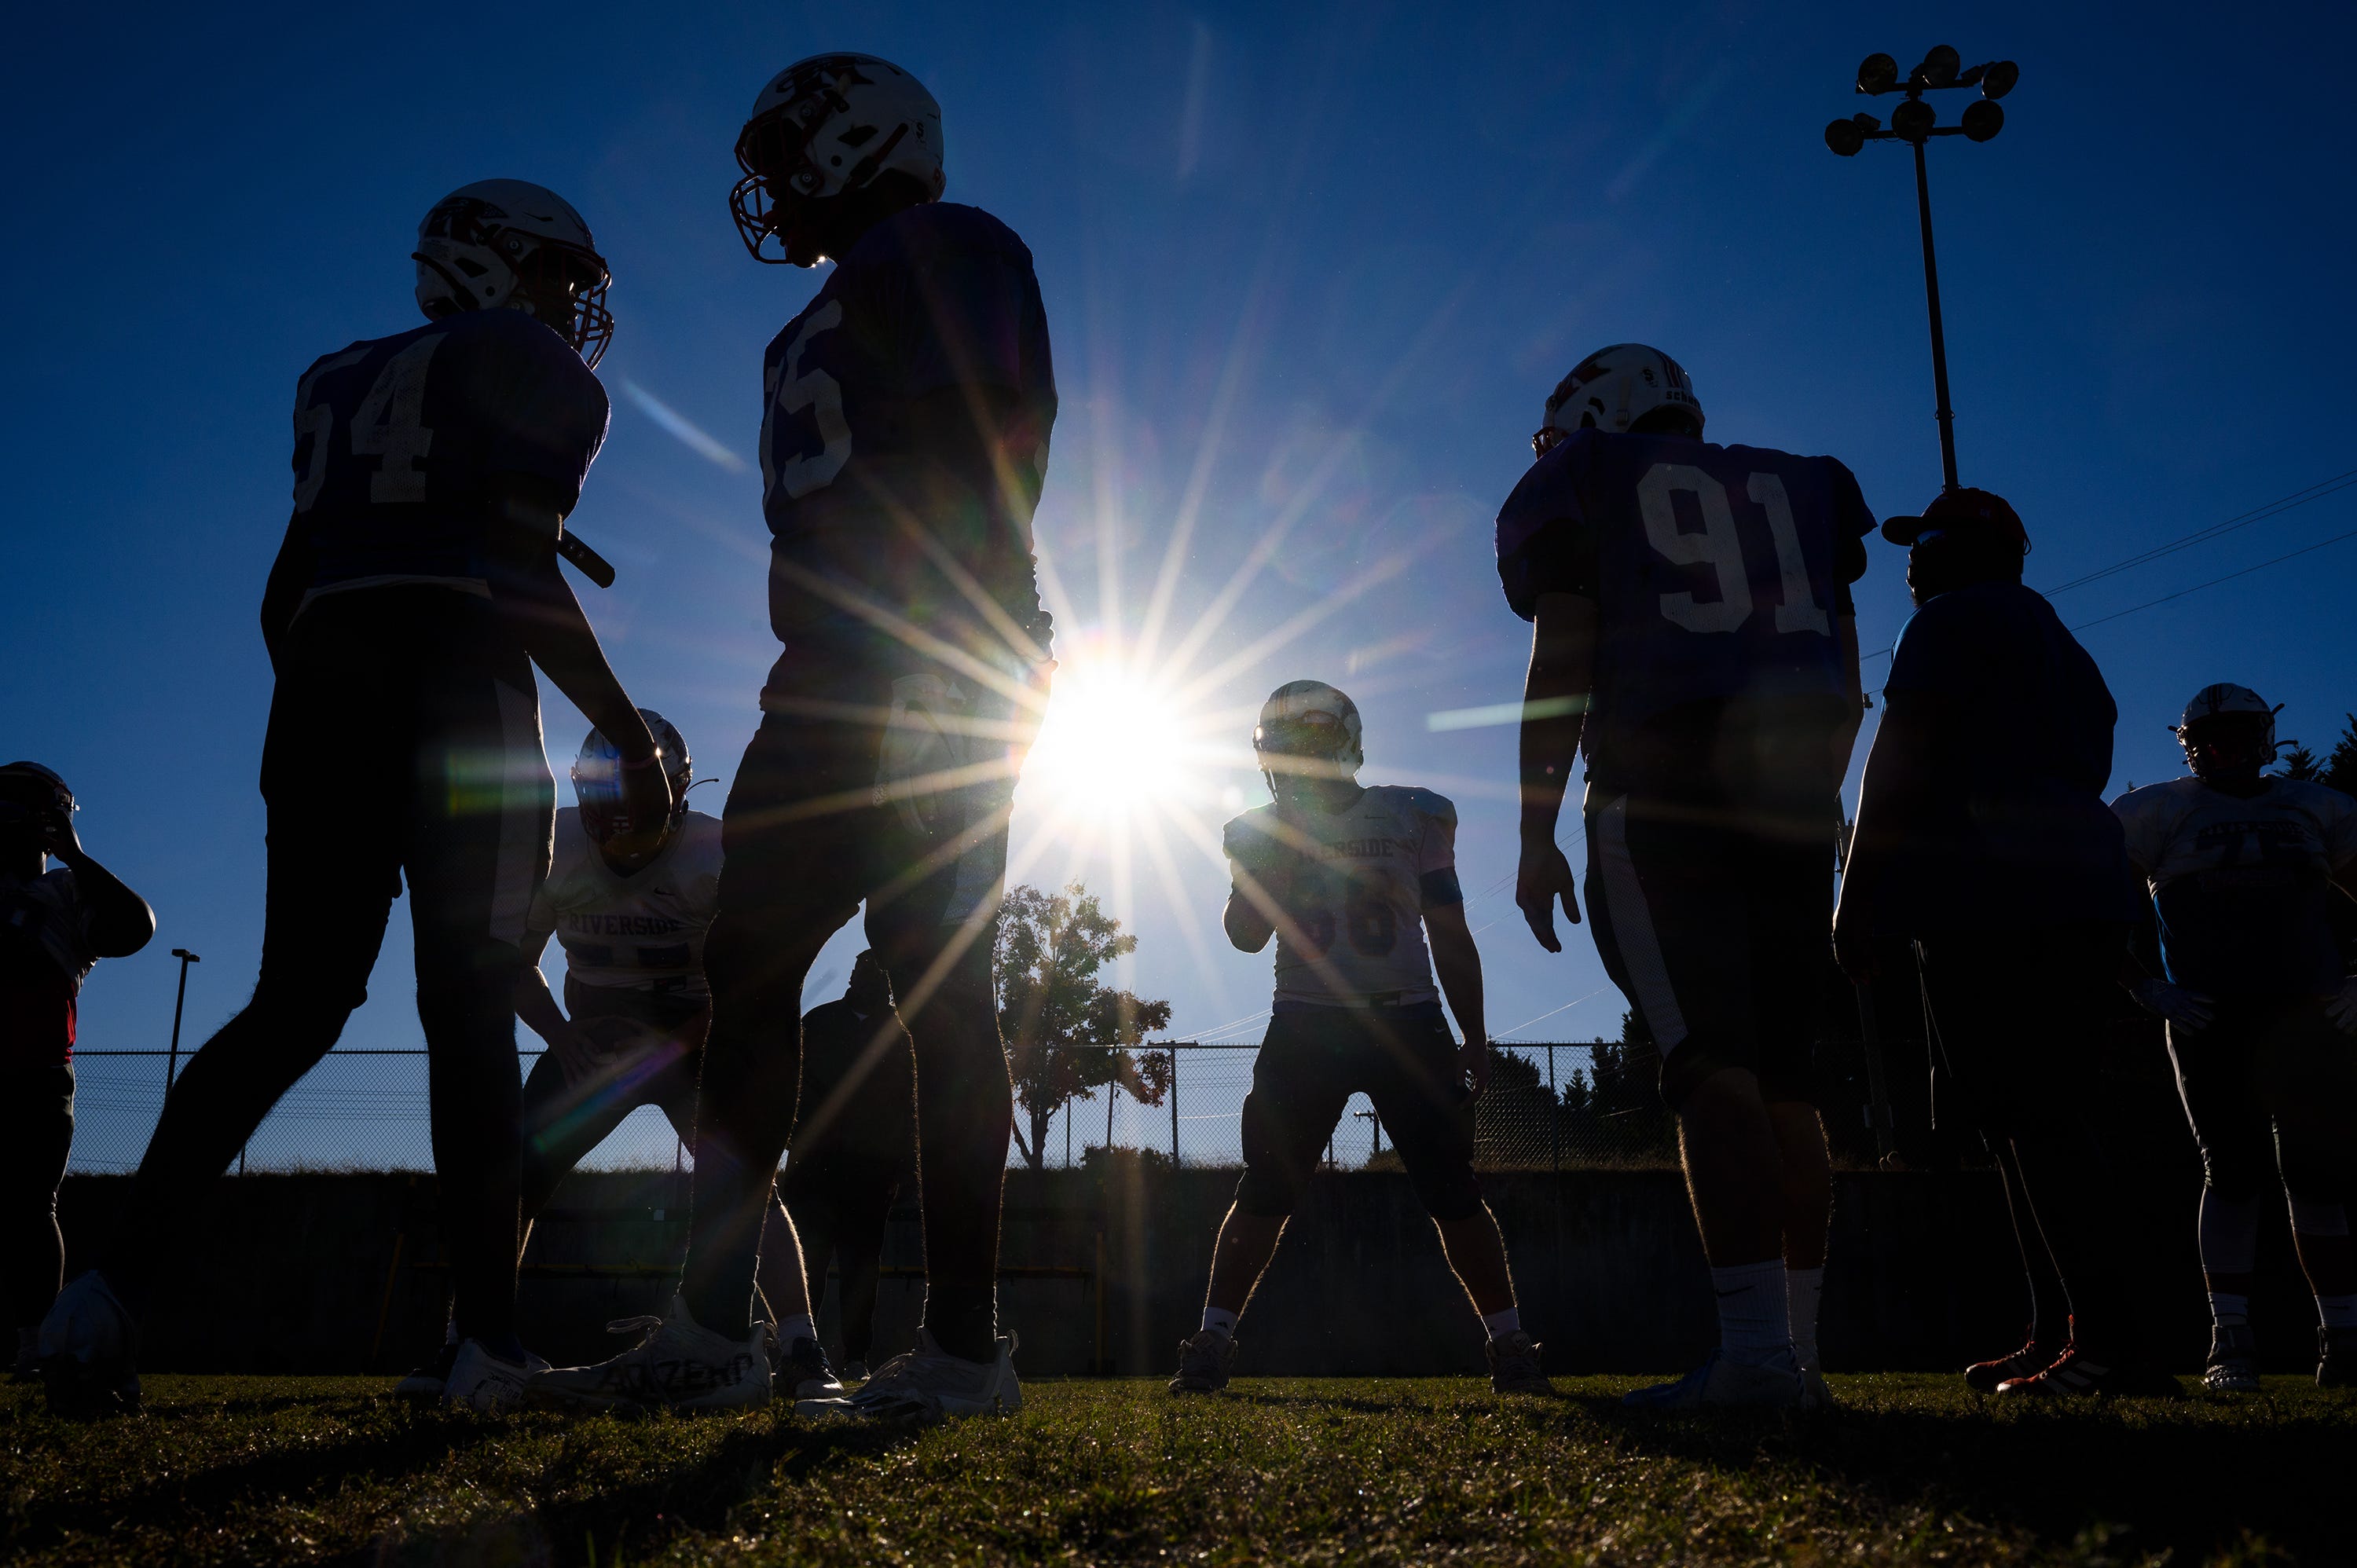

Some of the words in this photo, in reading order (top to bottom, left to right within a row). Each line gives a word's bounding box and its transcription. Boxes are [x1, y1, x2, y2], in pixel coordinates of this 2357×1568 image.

[295, 332, 452, 514] 54
[1636, 462, 1831, 636] 91
[569, 914, 681, 936] RIVERSIDE
